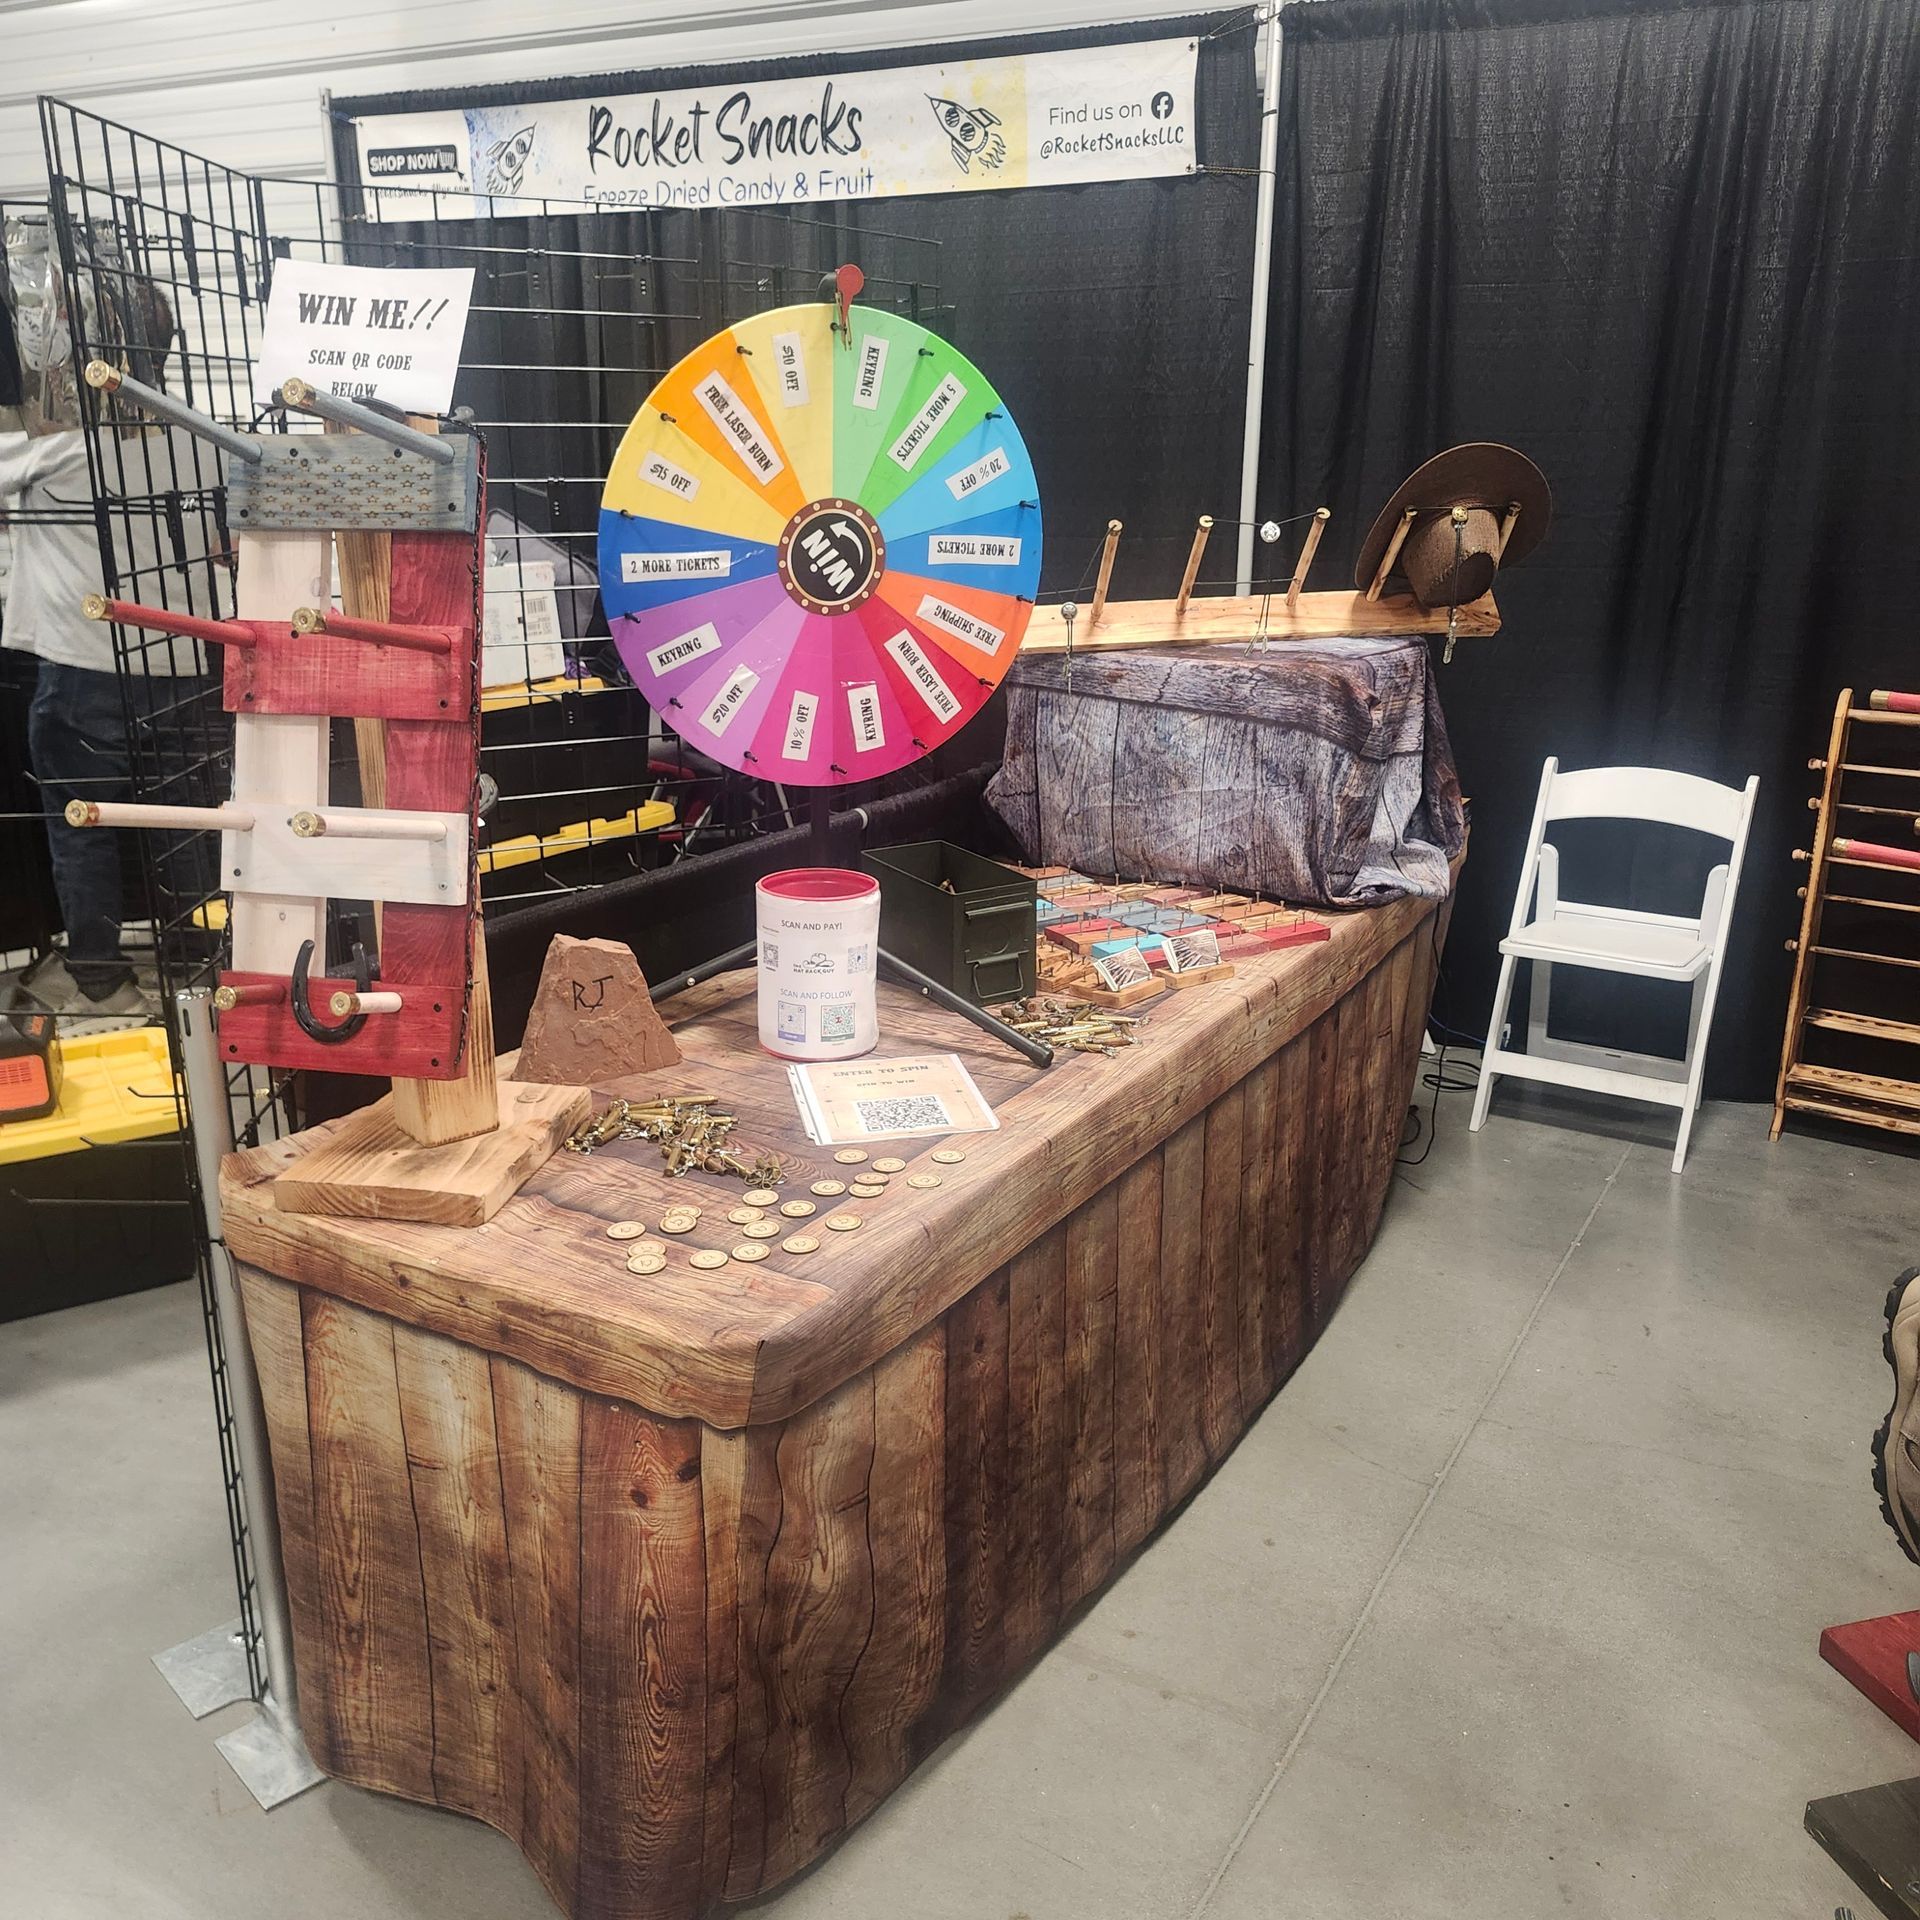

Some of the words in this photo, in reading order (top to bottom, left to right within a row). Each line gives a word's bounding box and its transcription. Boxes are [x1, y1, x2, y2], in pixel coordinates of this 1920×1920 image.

[1049, 103, 1087, 125] Find
[1093, 106, 1114, 121] us
[1118, 103, 1142, 119] on
[587, 98, 710, 175] Rocket
[716, 81, 862, 165] Snacks
[1040, 126, 1184, 159] @RocketSnacksLLC
[369, 155, 406, 173] SHOP
[407, 152, 438, 171] NOW
[584, 185, 648, 208] Freeze
[656, 177, 710, 205] Dried
[719, 173, 786, 205] Candy
[793, 172, 808, 199] &
[819, 167, 875, 196] Fruit
[299, 293, 357, 326] WIN
[366, 298, 449, 330] ME!!
[308, 349, 346, 366] SCAN
[352, 352, 370, 371] QR
[376, 354, 412, 371] CODE
[785, 371, 799, 392] OFF
[860, 346, 880, 398] KEYRING
[331, 381, 378, 398] BELOW
[946, 384, 956, 395] 5
[926, 391, 951, 421] MORE
[704, 384, 729, 414] FREE
[724, 410, 751, 446] LASER
[748, 442, 773, 472] BURN
[896, 421, 930, 461] TICKETS
[670, 472, 691, 493] OFF
[959, 472, 977, 492] OFF
[937, 541, 976, 555] TICKETS
[979, 542, 1005, 556] MORE
[1008, 544, 1015, 556] 2
[631, 561, 638, 573] 2
[642, 559, 672, 573] MORE
[677, 557, 720, 571] TICKETS
[934, 604, 975, 634] SHIPPING
[974, 627, 997, 647] FREE
[657, 636, 702, 667] KEYRING
[897, 640, 916, 666] BURN
[915, 663, 938, 688] LASER
[712, 704, 730, 723] $20
[726, 683, 744, 704] OFF
[934, 687, 954, 714] FREE
[796, 704, 810, 723] OFF
[860, 697, 877, 741] KEYRING
[781, 919, 801, 929] SCAN
[802, 922, 821, 931] AND
[823, 922, 842, 930] PAY!
[780, 988, 799, 999] SCAN
[800, 991, 818, 1000] AND
[820, 990, 853, 1000] FOLLOW
